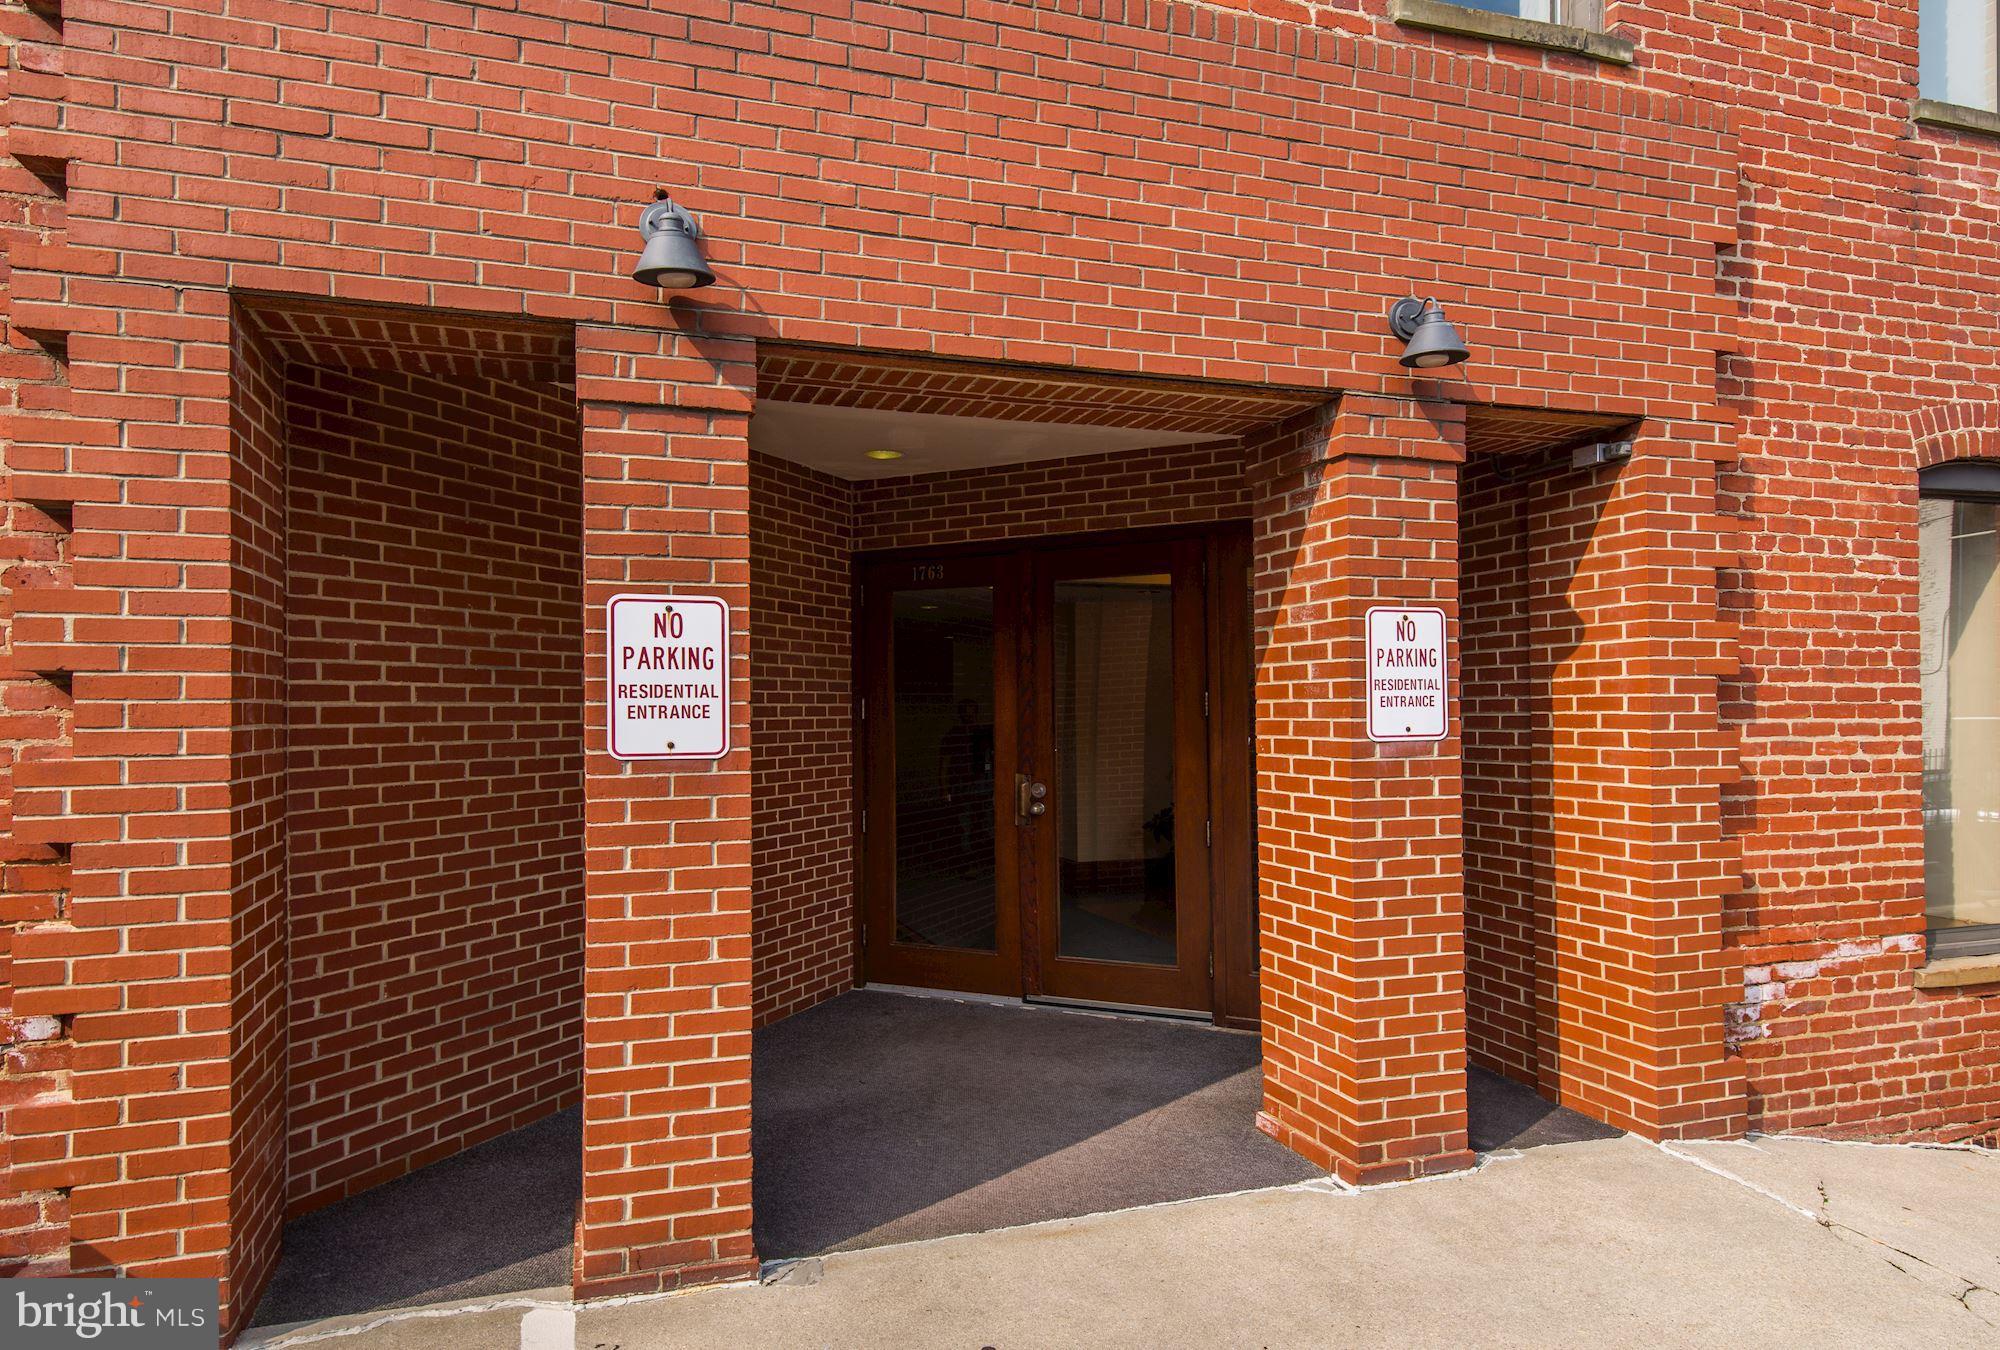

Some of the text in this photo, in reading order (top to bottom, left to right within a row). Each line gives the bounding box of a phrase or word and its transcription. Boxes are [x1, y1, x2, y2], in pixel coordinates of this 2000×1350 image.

[912, 564, 944, 581] 1763
[654, 612, 684, 639] NO
[1396, 620, 1416, 642] NO
[623, 646, 714, 671] PARKING
[1376, 648, 1437, 668] PARKING
[618, 684, 719, 699] RESIDENTIAL
[1374, 678, 1441, 691] RESIDENTIAL
[1380, 695, 1435, 708] ENTRANCE
[627, 704, 711, 720] ENTRANCE
